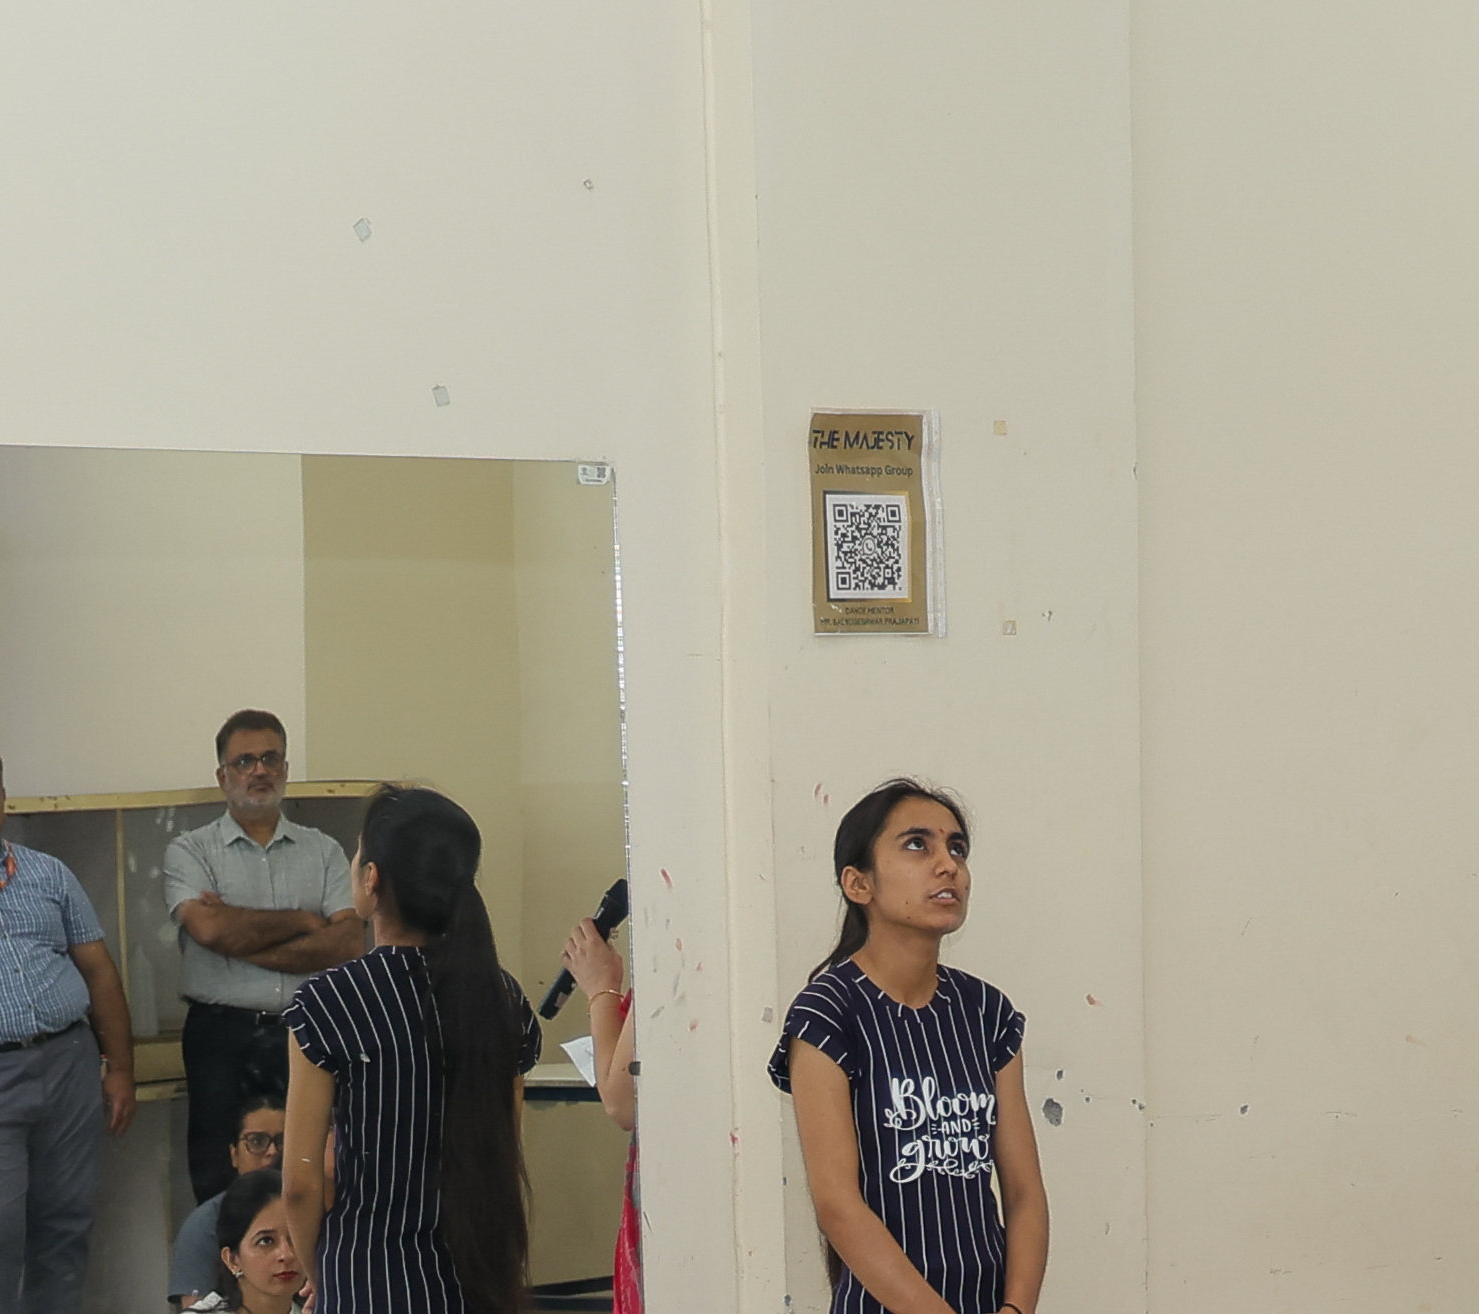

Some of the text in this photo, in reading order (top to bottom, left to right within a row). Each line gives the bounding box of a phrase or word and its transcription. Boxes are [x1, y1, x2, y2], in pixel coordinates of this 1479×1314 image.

[812, 429, 915, 450] THE MAJESTY
[815, 463, 914, 477] Join Whatsapp Group
[883, 1076, 997, 1131] Bloom
[938, 1118, 972, 1135] AND
[889, 1133, 991, 1184] grow
